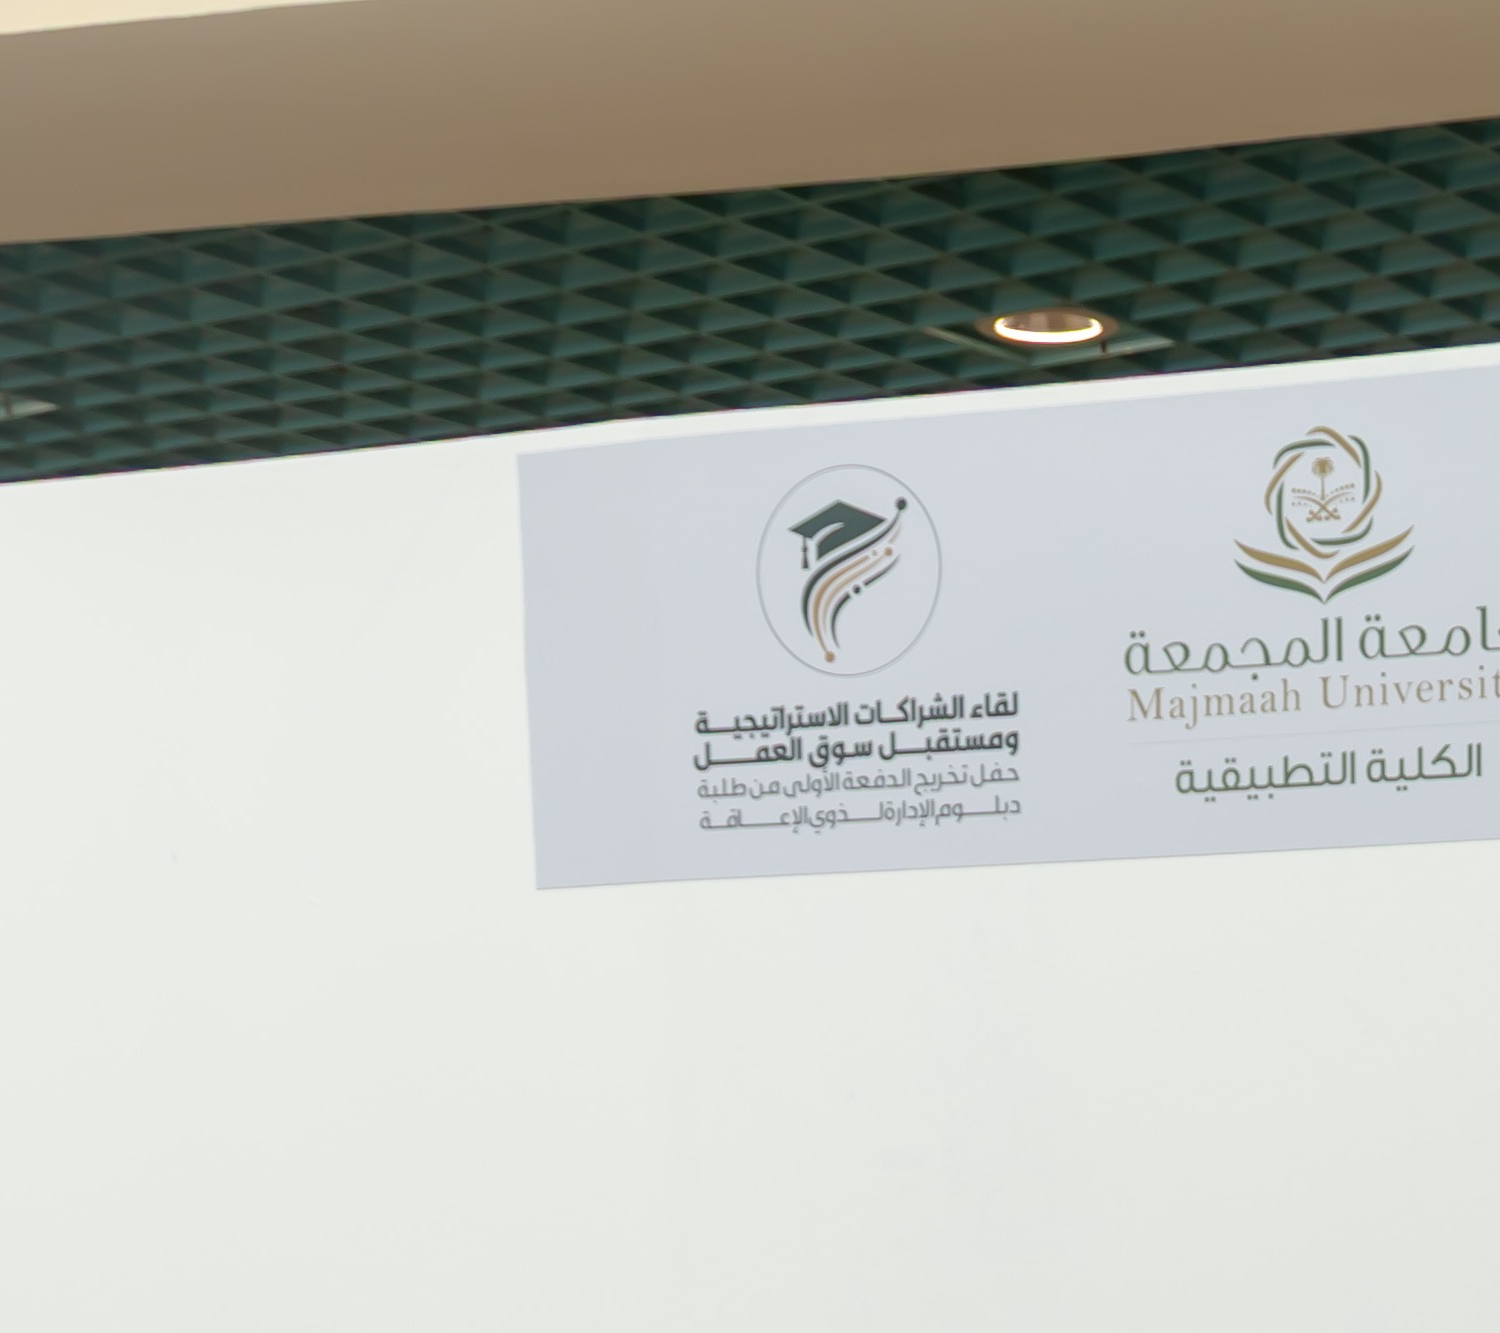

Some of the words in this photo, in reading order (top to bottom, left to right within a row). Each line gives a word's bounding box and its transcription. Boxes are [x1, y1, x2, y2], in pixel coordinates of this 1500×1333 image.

[1124, 617, 1343, 680] المجمعة
[855, 693, 964, 728] الشراكات
[969, 691, 1018, 719] لقاء
[1127, 678, 1301, 729] Majmaah
[695, 701, 849, 739] الاستراتيجية
[694, 737, 801, 770] العمل
[809, 738, 872, 767] سوق
[878, 728, 1018, 760] ومستقبل
[783, 768, 840, 796] الأولى
[844, 768, 910, 789] الدفعة
[914, 764, 967, 794] تخريج
[971, 762, 1019, 787] حفل
[1175, 751, 1356, 802] التطبيقية
[1367, 743, 1482, 791] الكلية
[698, 778, 746, 802] طلبة
[750, 778, 780, 799] من
[934, 796, 1020, 825] دبلوم
